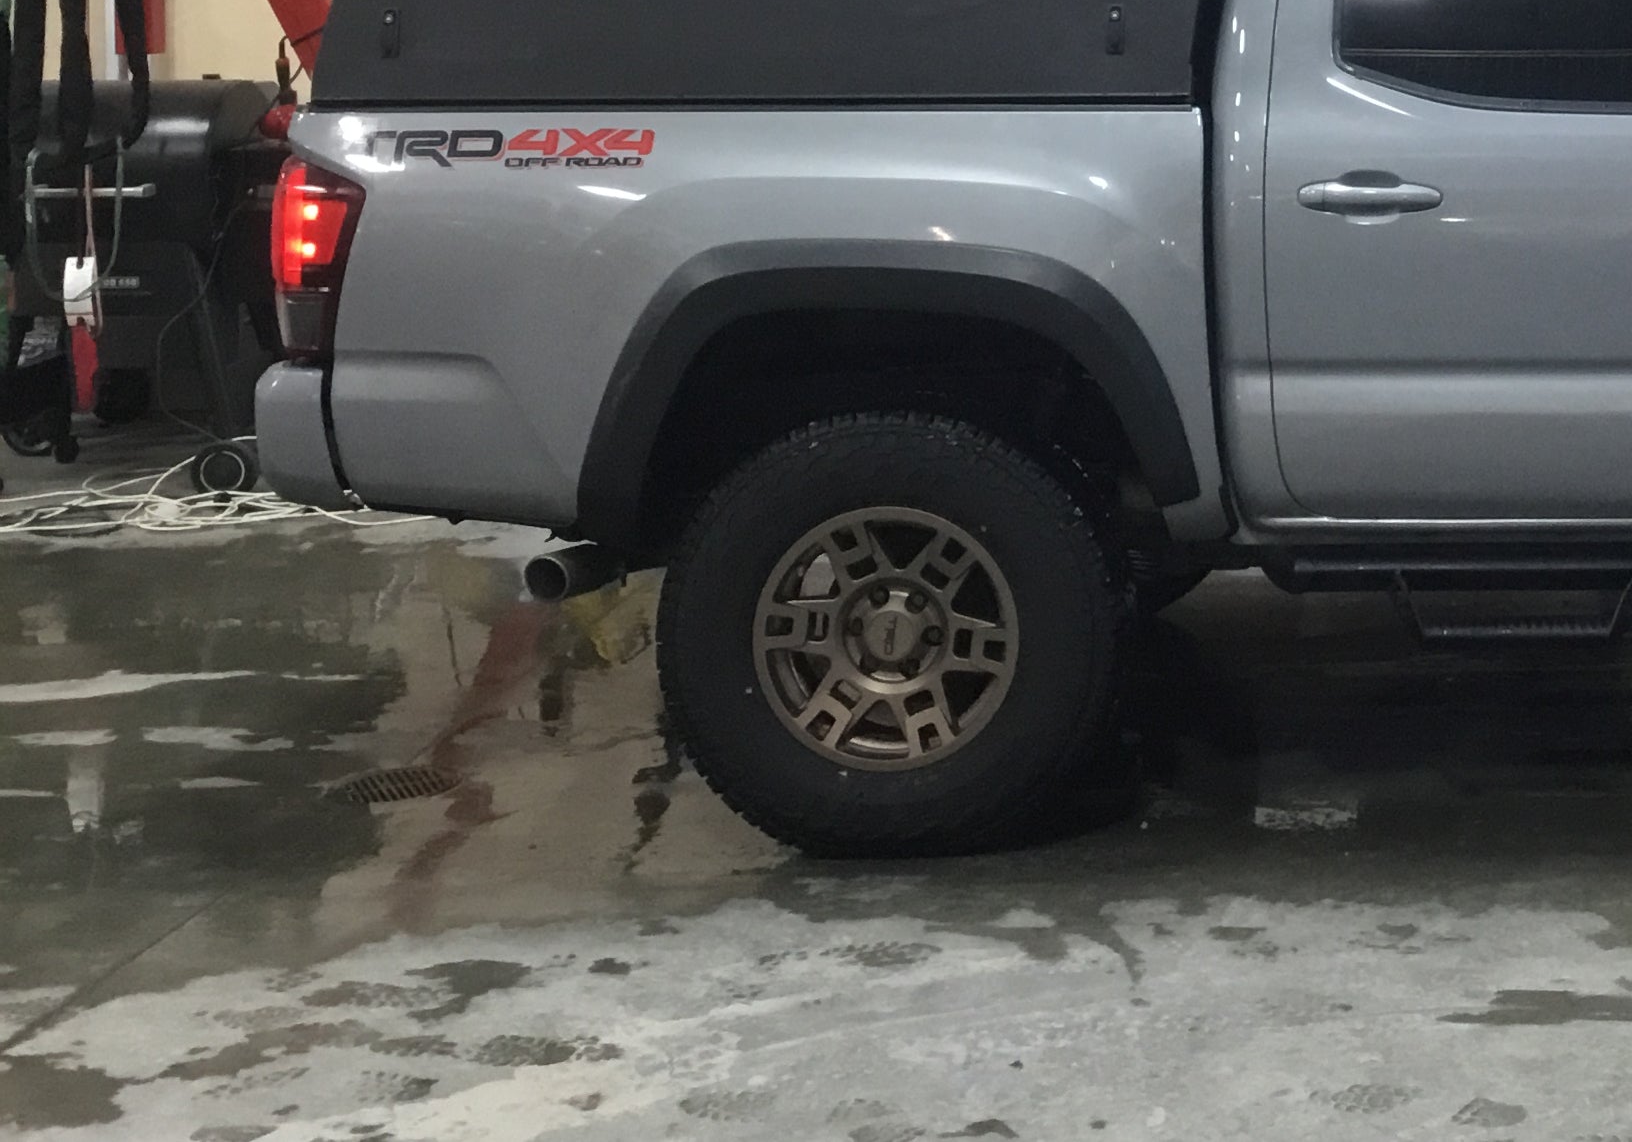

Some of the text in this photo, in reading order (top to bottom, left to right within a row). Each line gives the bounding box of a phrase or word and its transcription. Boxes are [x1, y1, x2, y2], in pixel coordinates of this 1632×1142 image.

[366, 129, 504, 167] TRD
[504, 157, 644, 169] OFF ROAD
